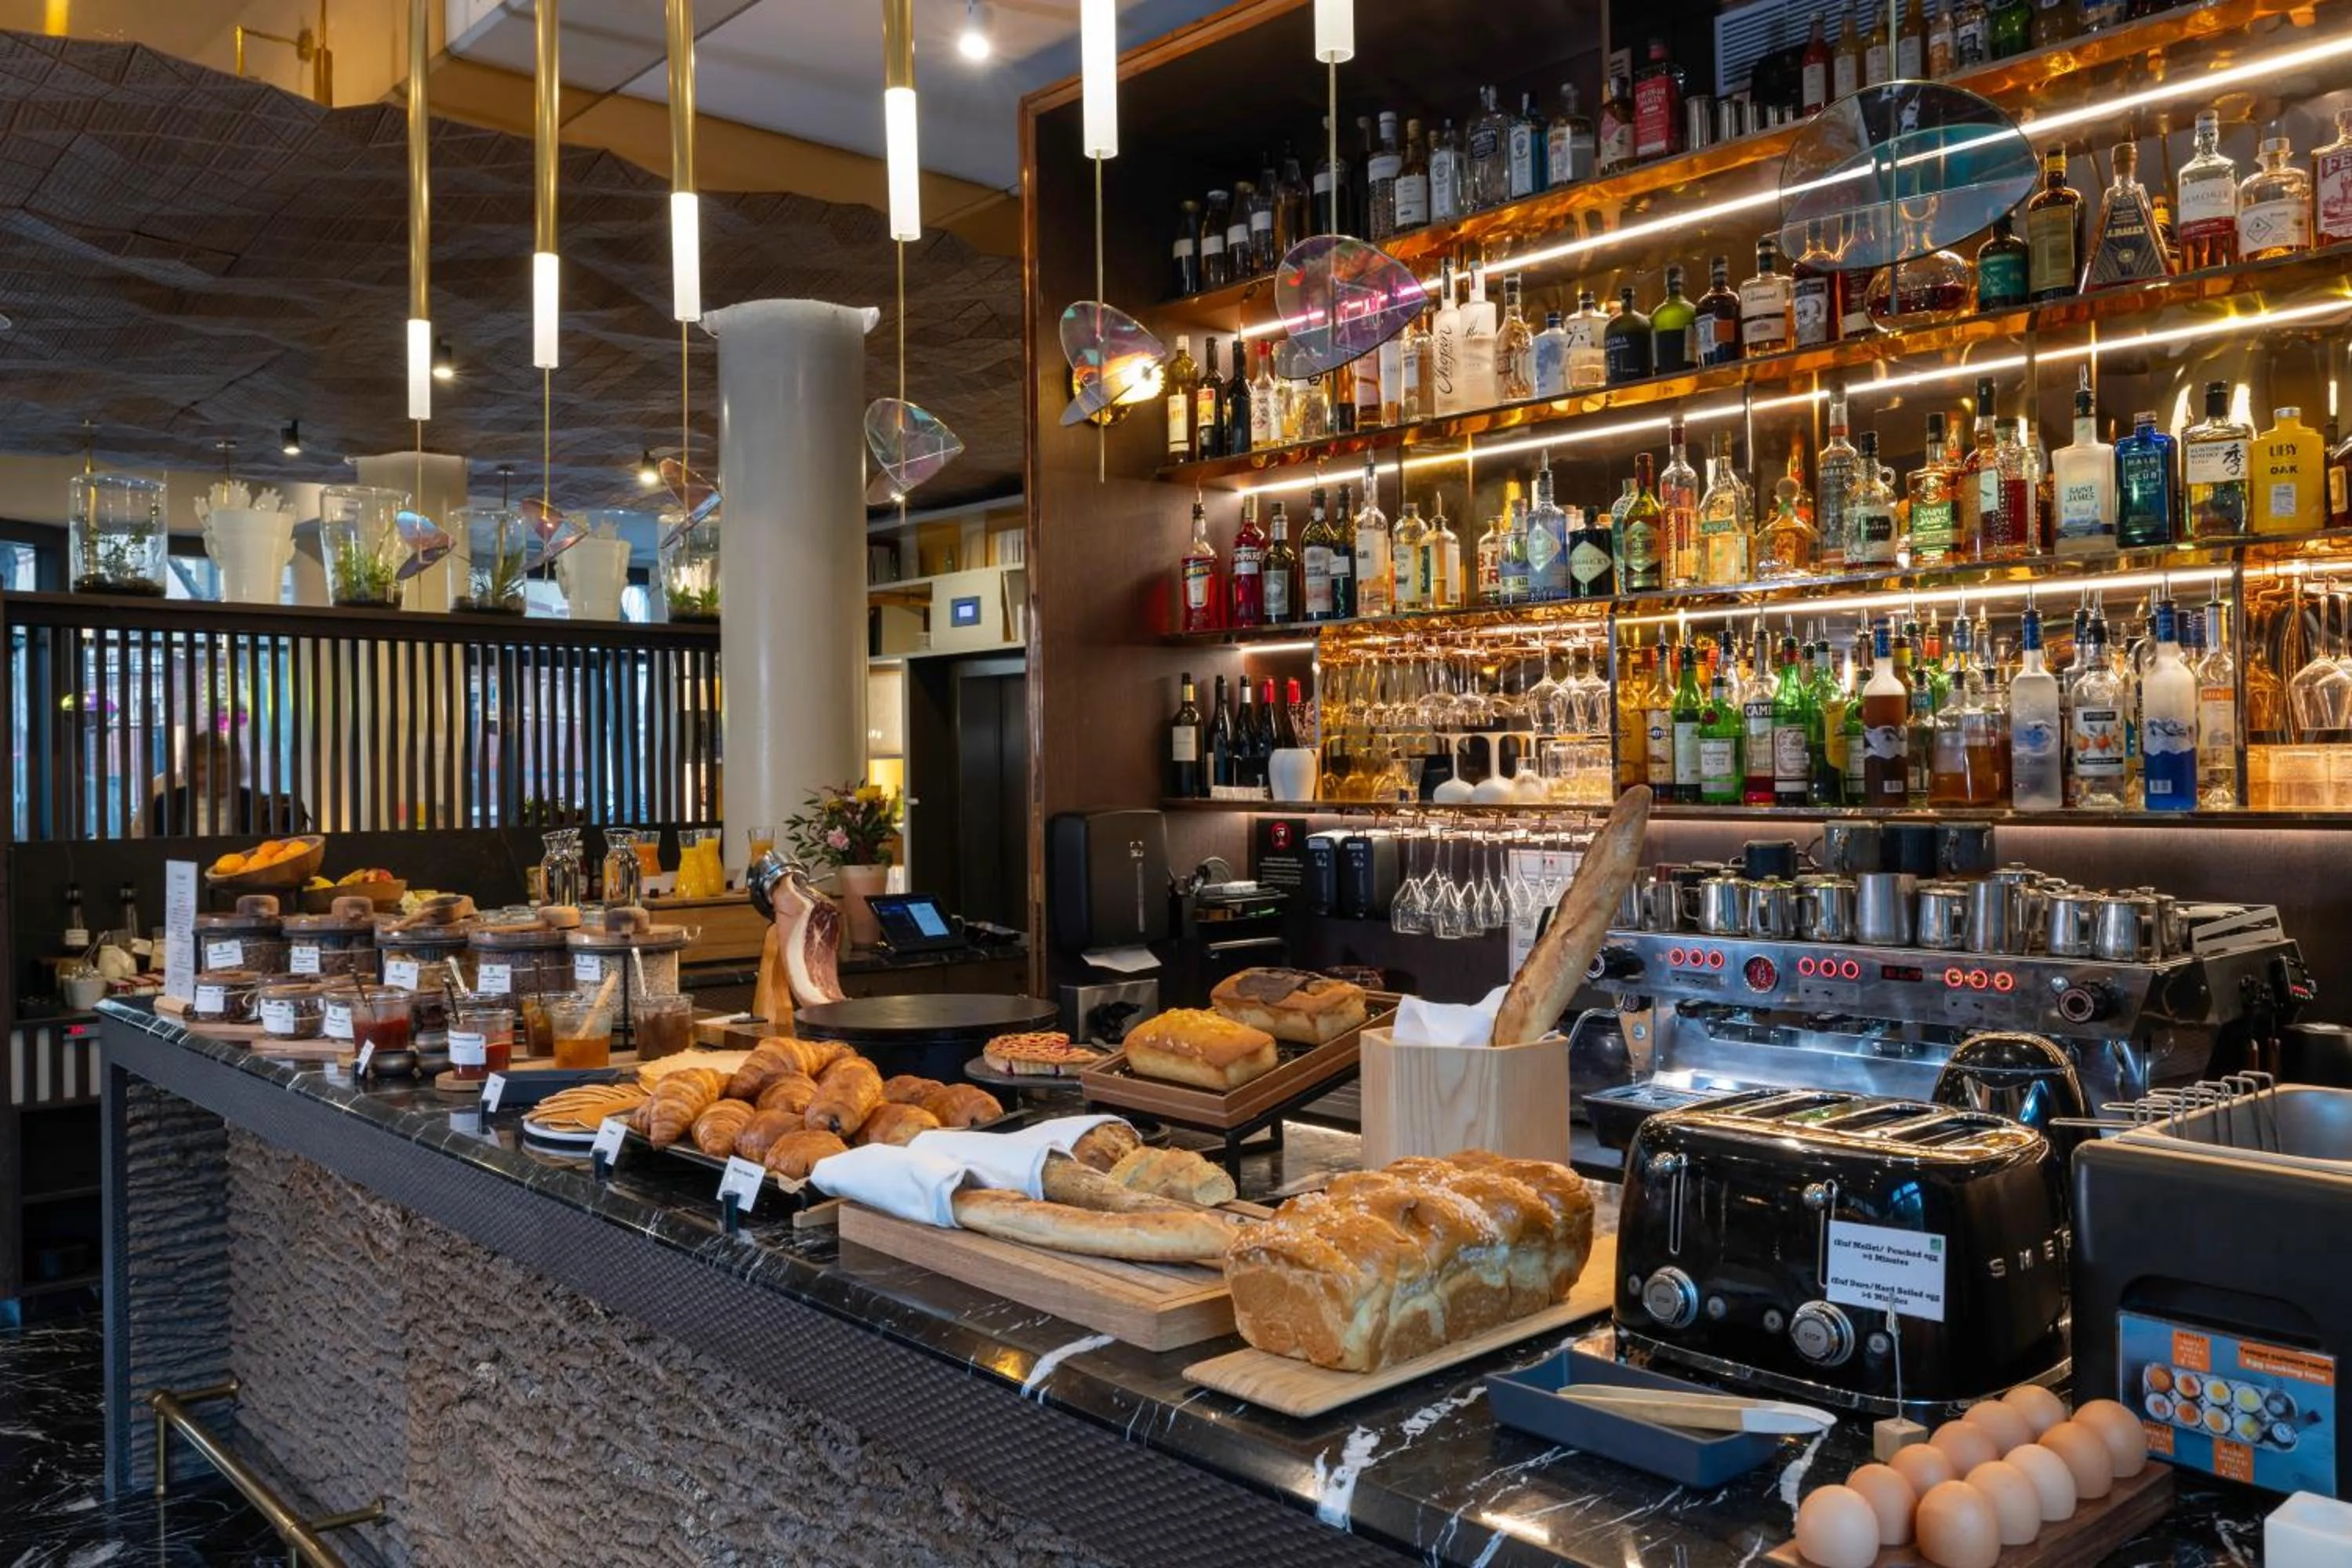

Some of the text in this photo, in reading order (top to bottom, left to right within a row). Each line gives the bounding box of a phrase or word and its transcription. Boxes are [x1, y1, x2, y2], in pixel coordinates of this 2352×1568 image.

[1436, 325, 1454, 394] Chopin
[2067, 492, 2095, 503] JAMES
[1875, 1255, 1909, 1266] Minutes
[1924, 1254, 1939, 1262] egg
[1874, 1294, 1908, 1305] Mintes
[1896, 1287, 1923, 1298] Boiled
[1926, 1294, 1940, 1302] egg
